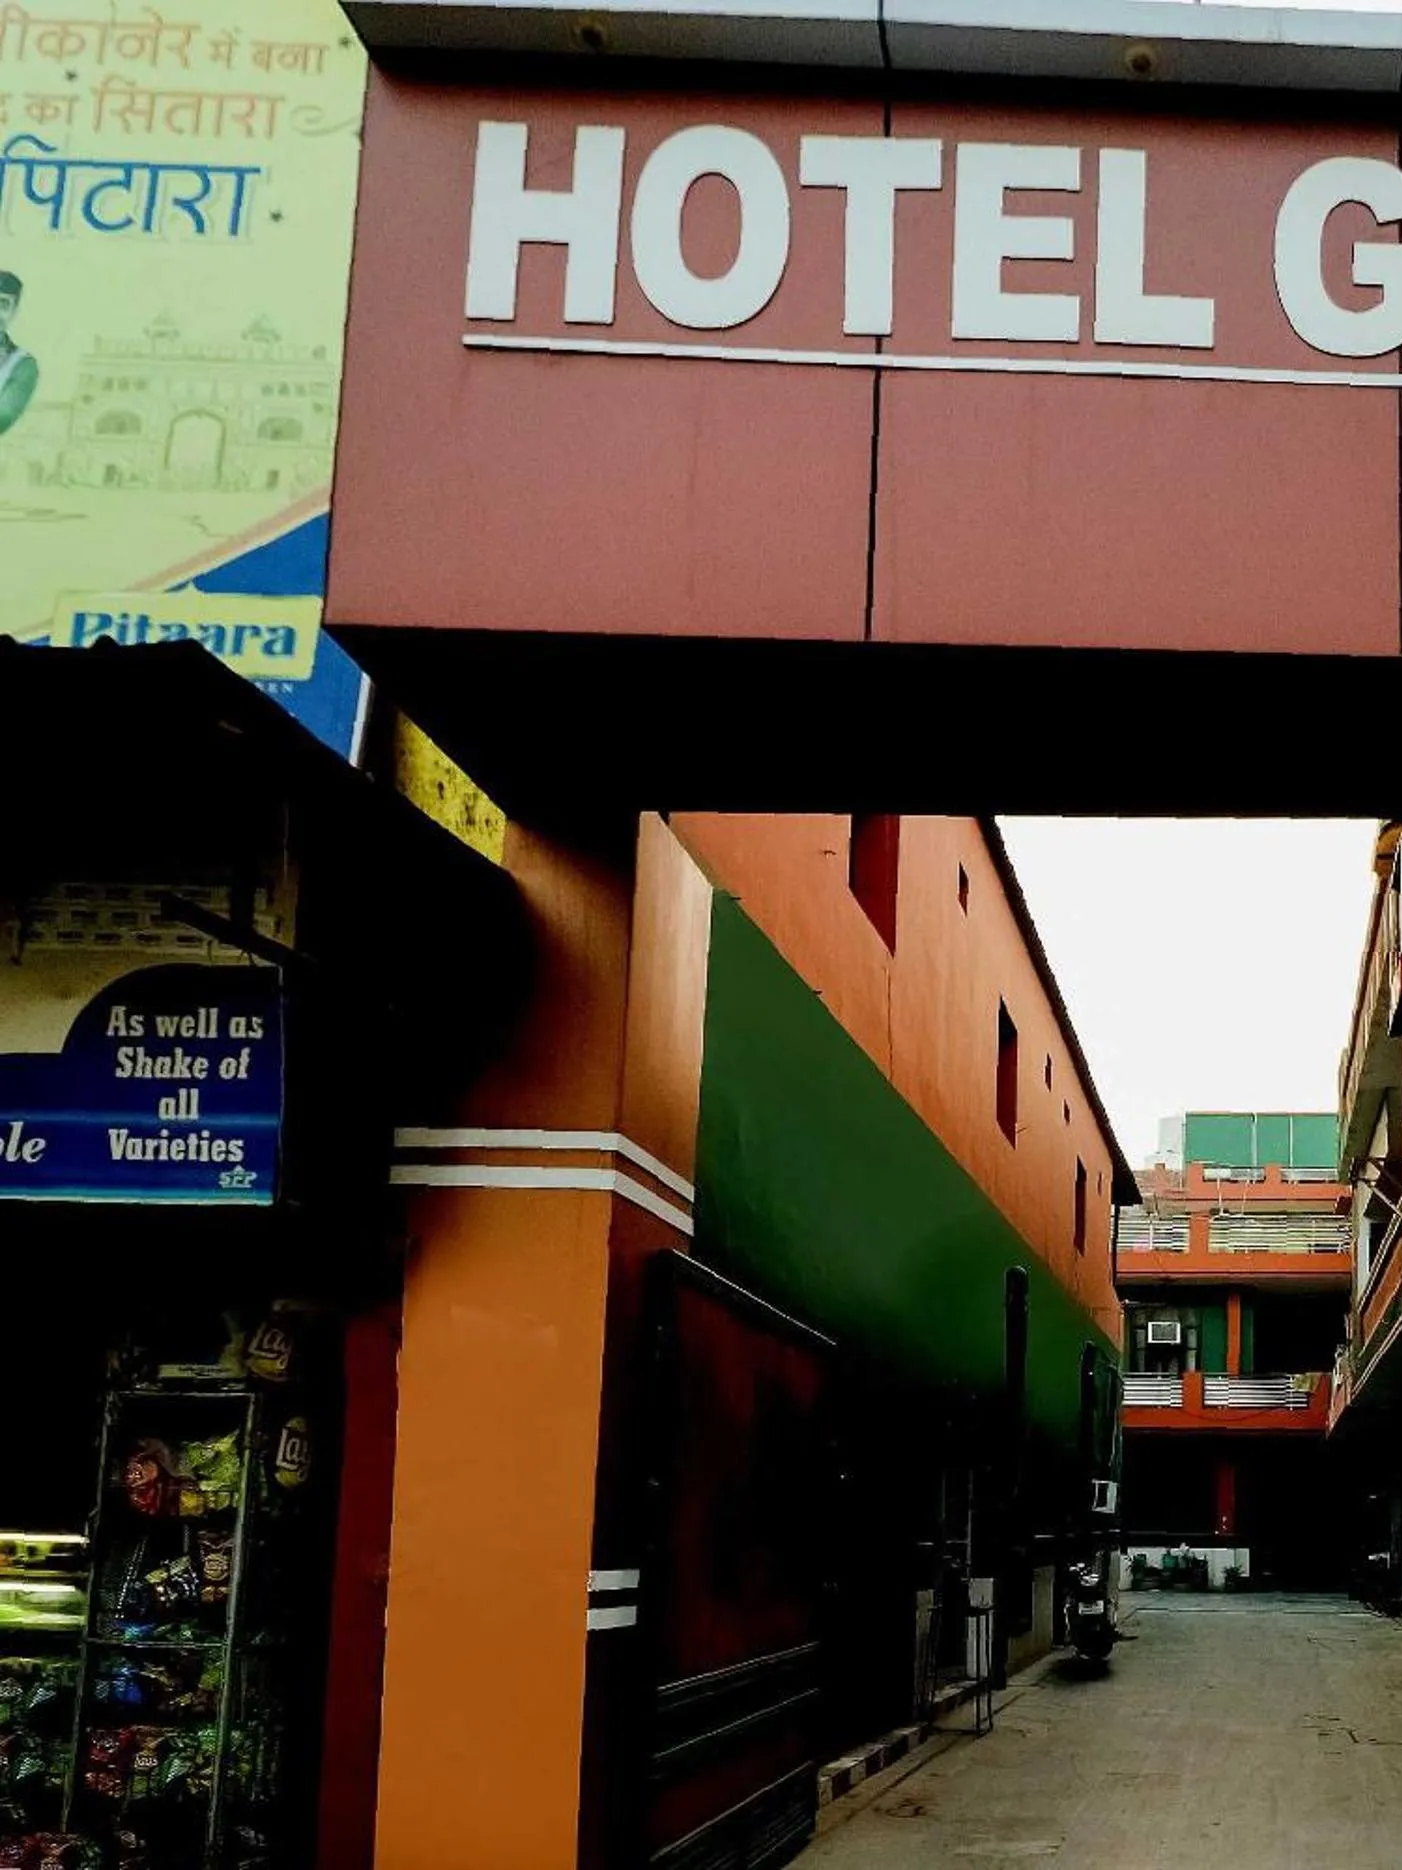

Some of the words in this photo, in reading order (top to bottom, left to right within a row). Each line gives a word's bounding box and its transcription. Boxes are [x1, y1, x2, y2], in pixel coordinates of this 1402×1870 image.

[0, 3, 200, 69] ीकानेर
[207, 27, 244, 70] में
[249, 39, 328, 73] बना
[89, 74, 286, 139] सितारा
[463, 120, 1215, 349] HOTEL
[107, 1005, 145, 1038] As
[155, 1008, 219, 1039] well
[229, 1015, 264, 1040] as
[114, 1046, 209, 1079] Shake
[219, 1047, 251, 1079] of
[158, 1088, 200, 1121] all
[0, 1121, 46, 1163] le
[108, 1128, 245, 1162] Varieties
